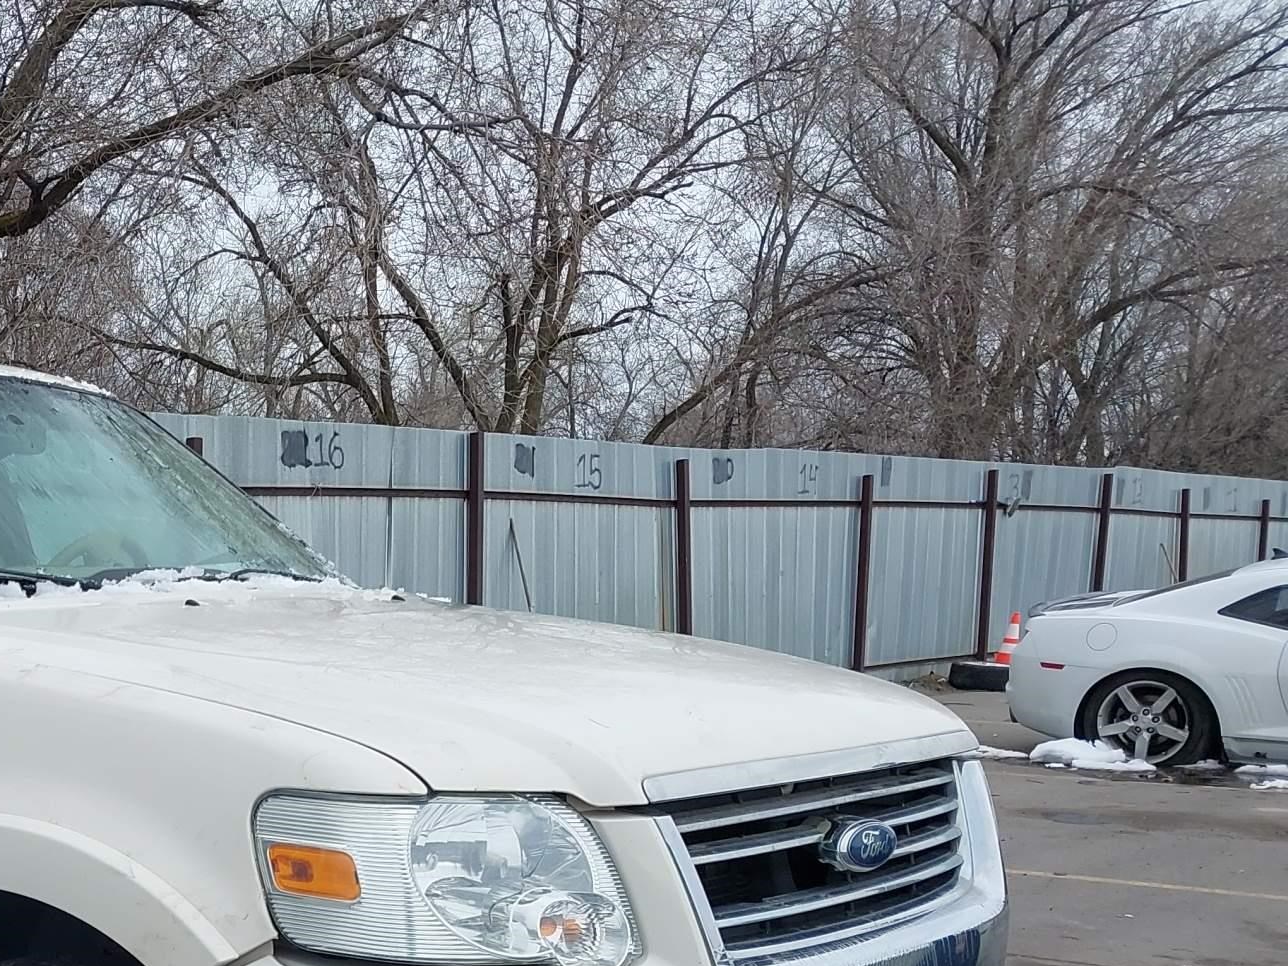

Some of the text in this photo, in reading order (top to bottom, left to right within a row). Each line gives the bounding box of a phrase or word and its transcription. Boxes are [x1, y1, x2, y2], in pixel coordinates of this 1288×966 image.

[314, 431, 345, 470] 16
[574, 453, 602, 490] 15
[797, 463, 820, 495] 14
[860, 829, 890, 859] Ford
